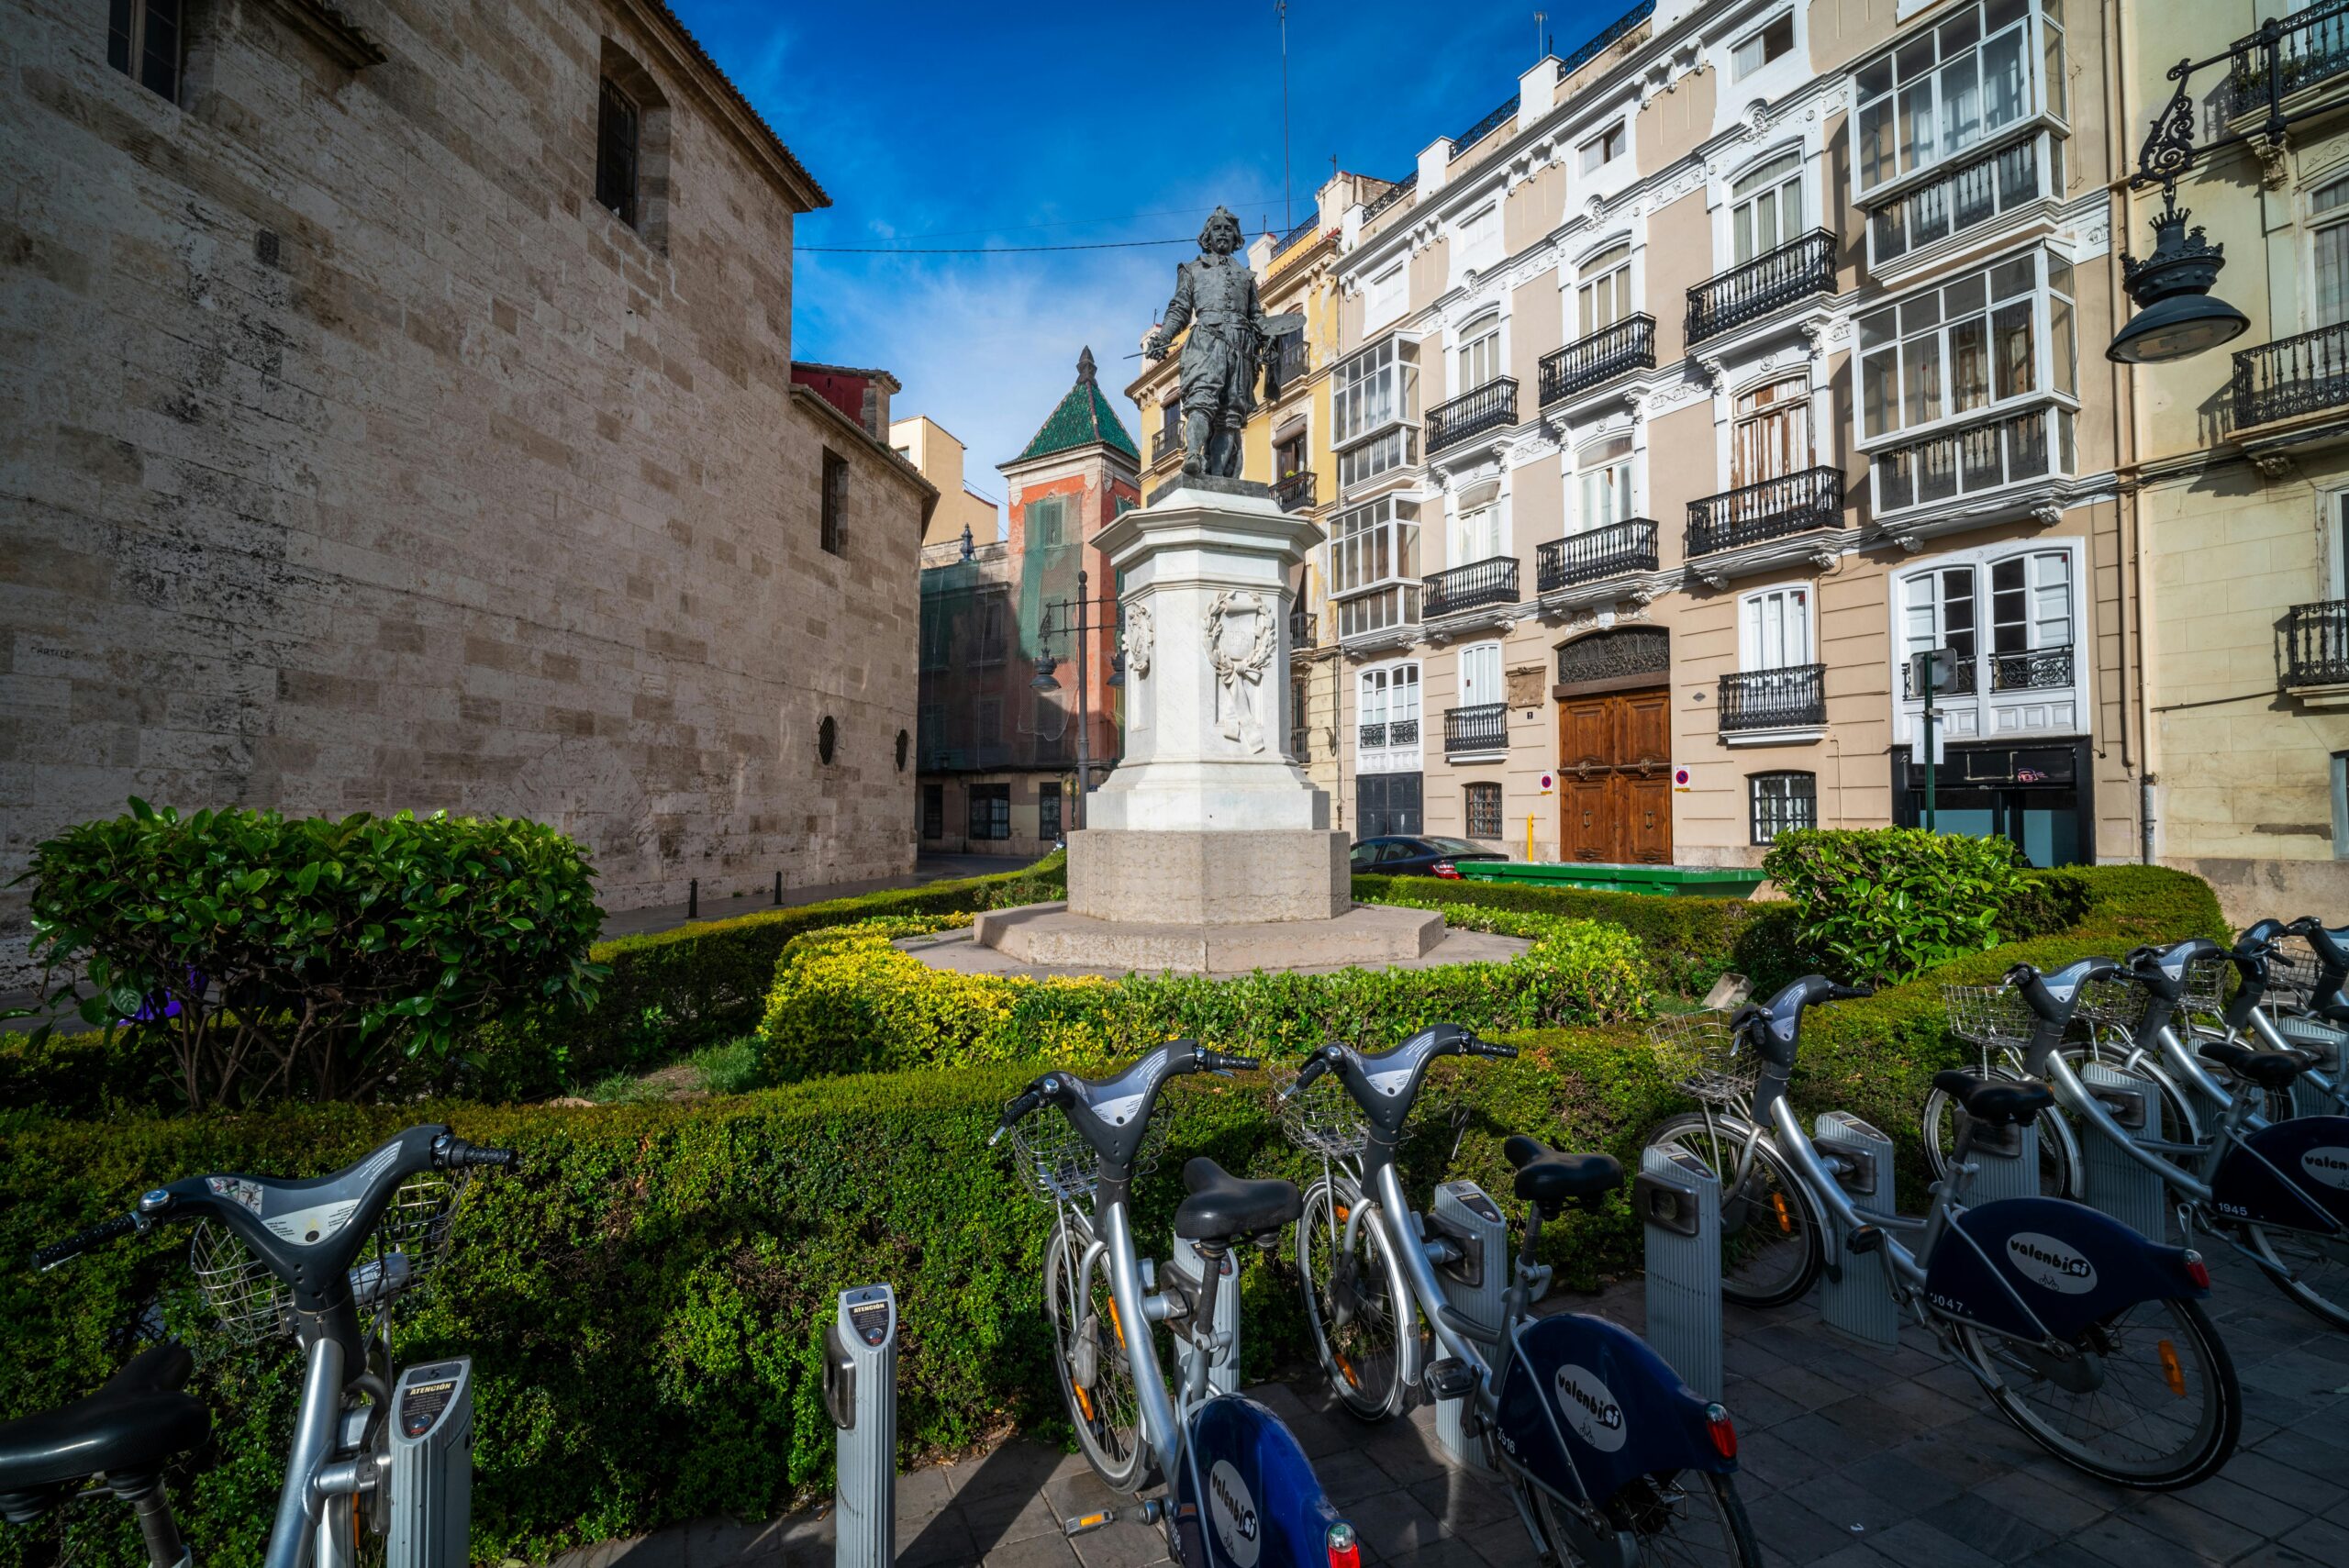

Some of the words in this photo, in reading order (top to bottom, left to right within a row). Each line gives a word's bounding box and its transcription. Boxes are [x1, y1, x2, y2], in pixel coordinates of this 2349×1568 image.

[2304, 1156, 2349, 1171] valen
[2218, 1202, 2248, 1217] 1945
[2010, 1240, 2089, 1276] valenbisi
[429, 1367, 440, 1379] 5
[409, 1382, 452, 1396] ATENCIÓN
[1558, 1373, 1620, 1429] valenbisi
[1497, 1426, 1516, 1454] 3516
[1212, 1471, 1256, 1539] valenbisi
